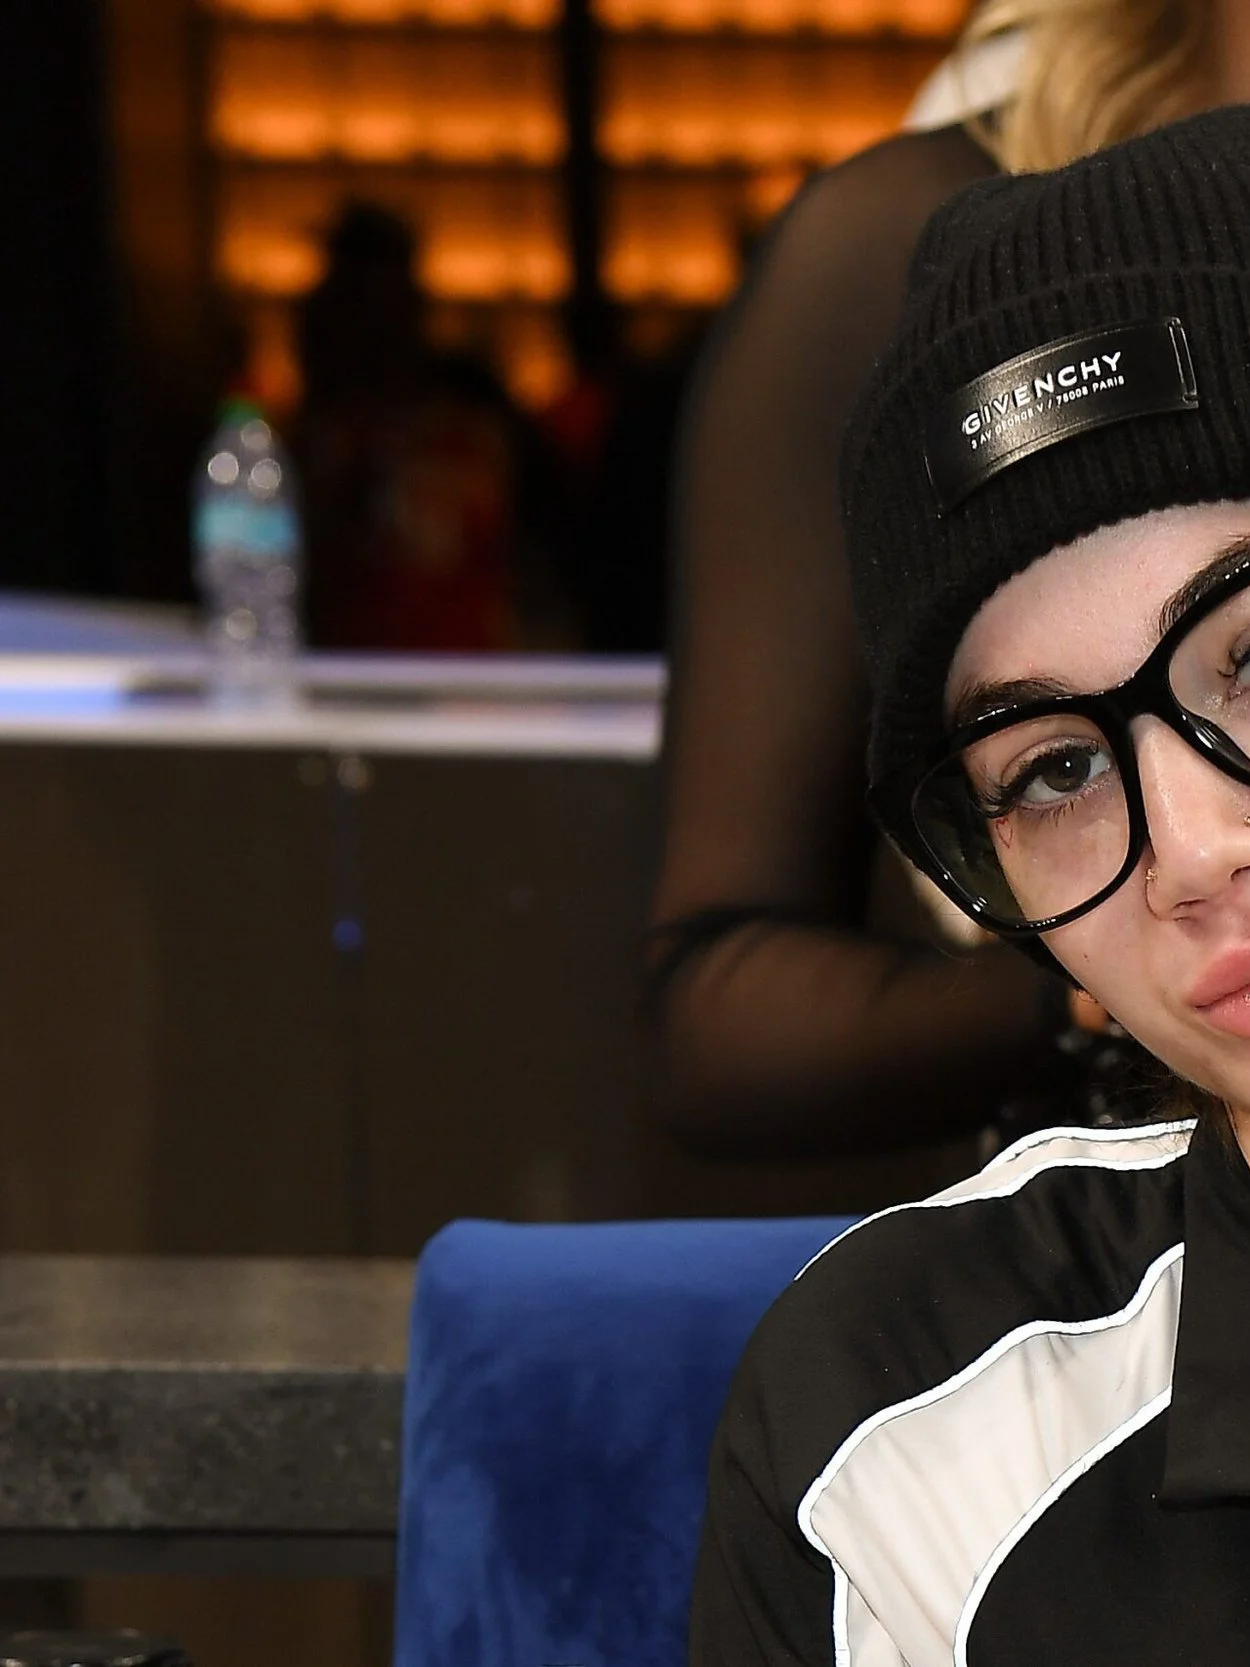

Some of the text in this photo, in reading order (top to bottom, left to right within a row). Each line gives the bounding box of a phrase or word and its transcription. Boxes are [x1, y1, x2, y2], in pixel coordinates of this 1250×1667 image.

[963, 351, 1121, 435] GIVENCHY
[980, 429, 992, 444] AV
[1036, 402, 1044, 413] V
[1092, 375, 1125, 393] PARIS
